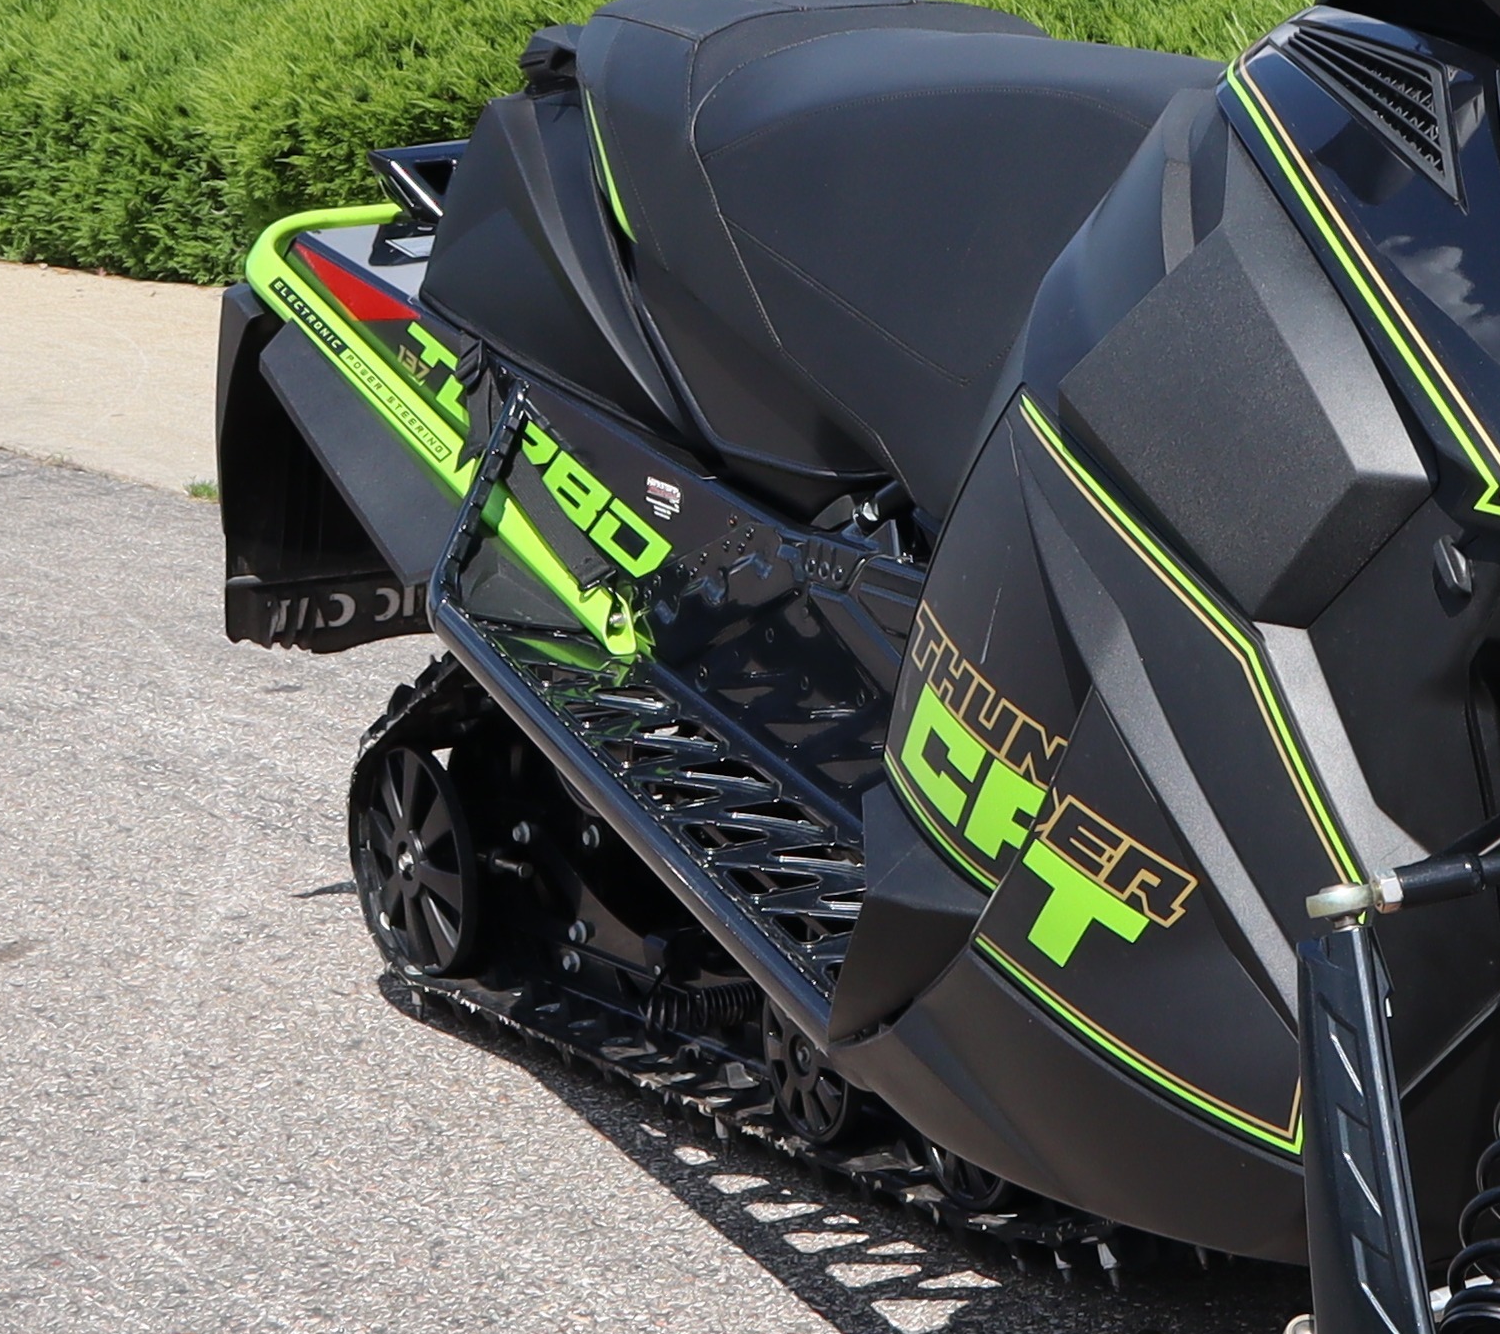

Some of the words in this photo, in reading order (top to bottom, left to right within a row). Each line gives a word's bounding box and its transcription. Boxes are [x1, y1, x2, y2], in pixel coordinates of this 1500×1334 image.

[272, 279, 343, 350] ELECTRONIC
[345, 353, 383, 391] POWER
[386, 395, 444, 455] STEERING
[397, 345, 431, 383] 137
[911, 600, 1198, 927] THUNER
